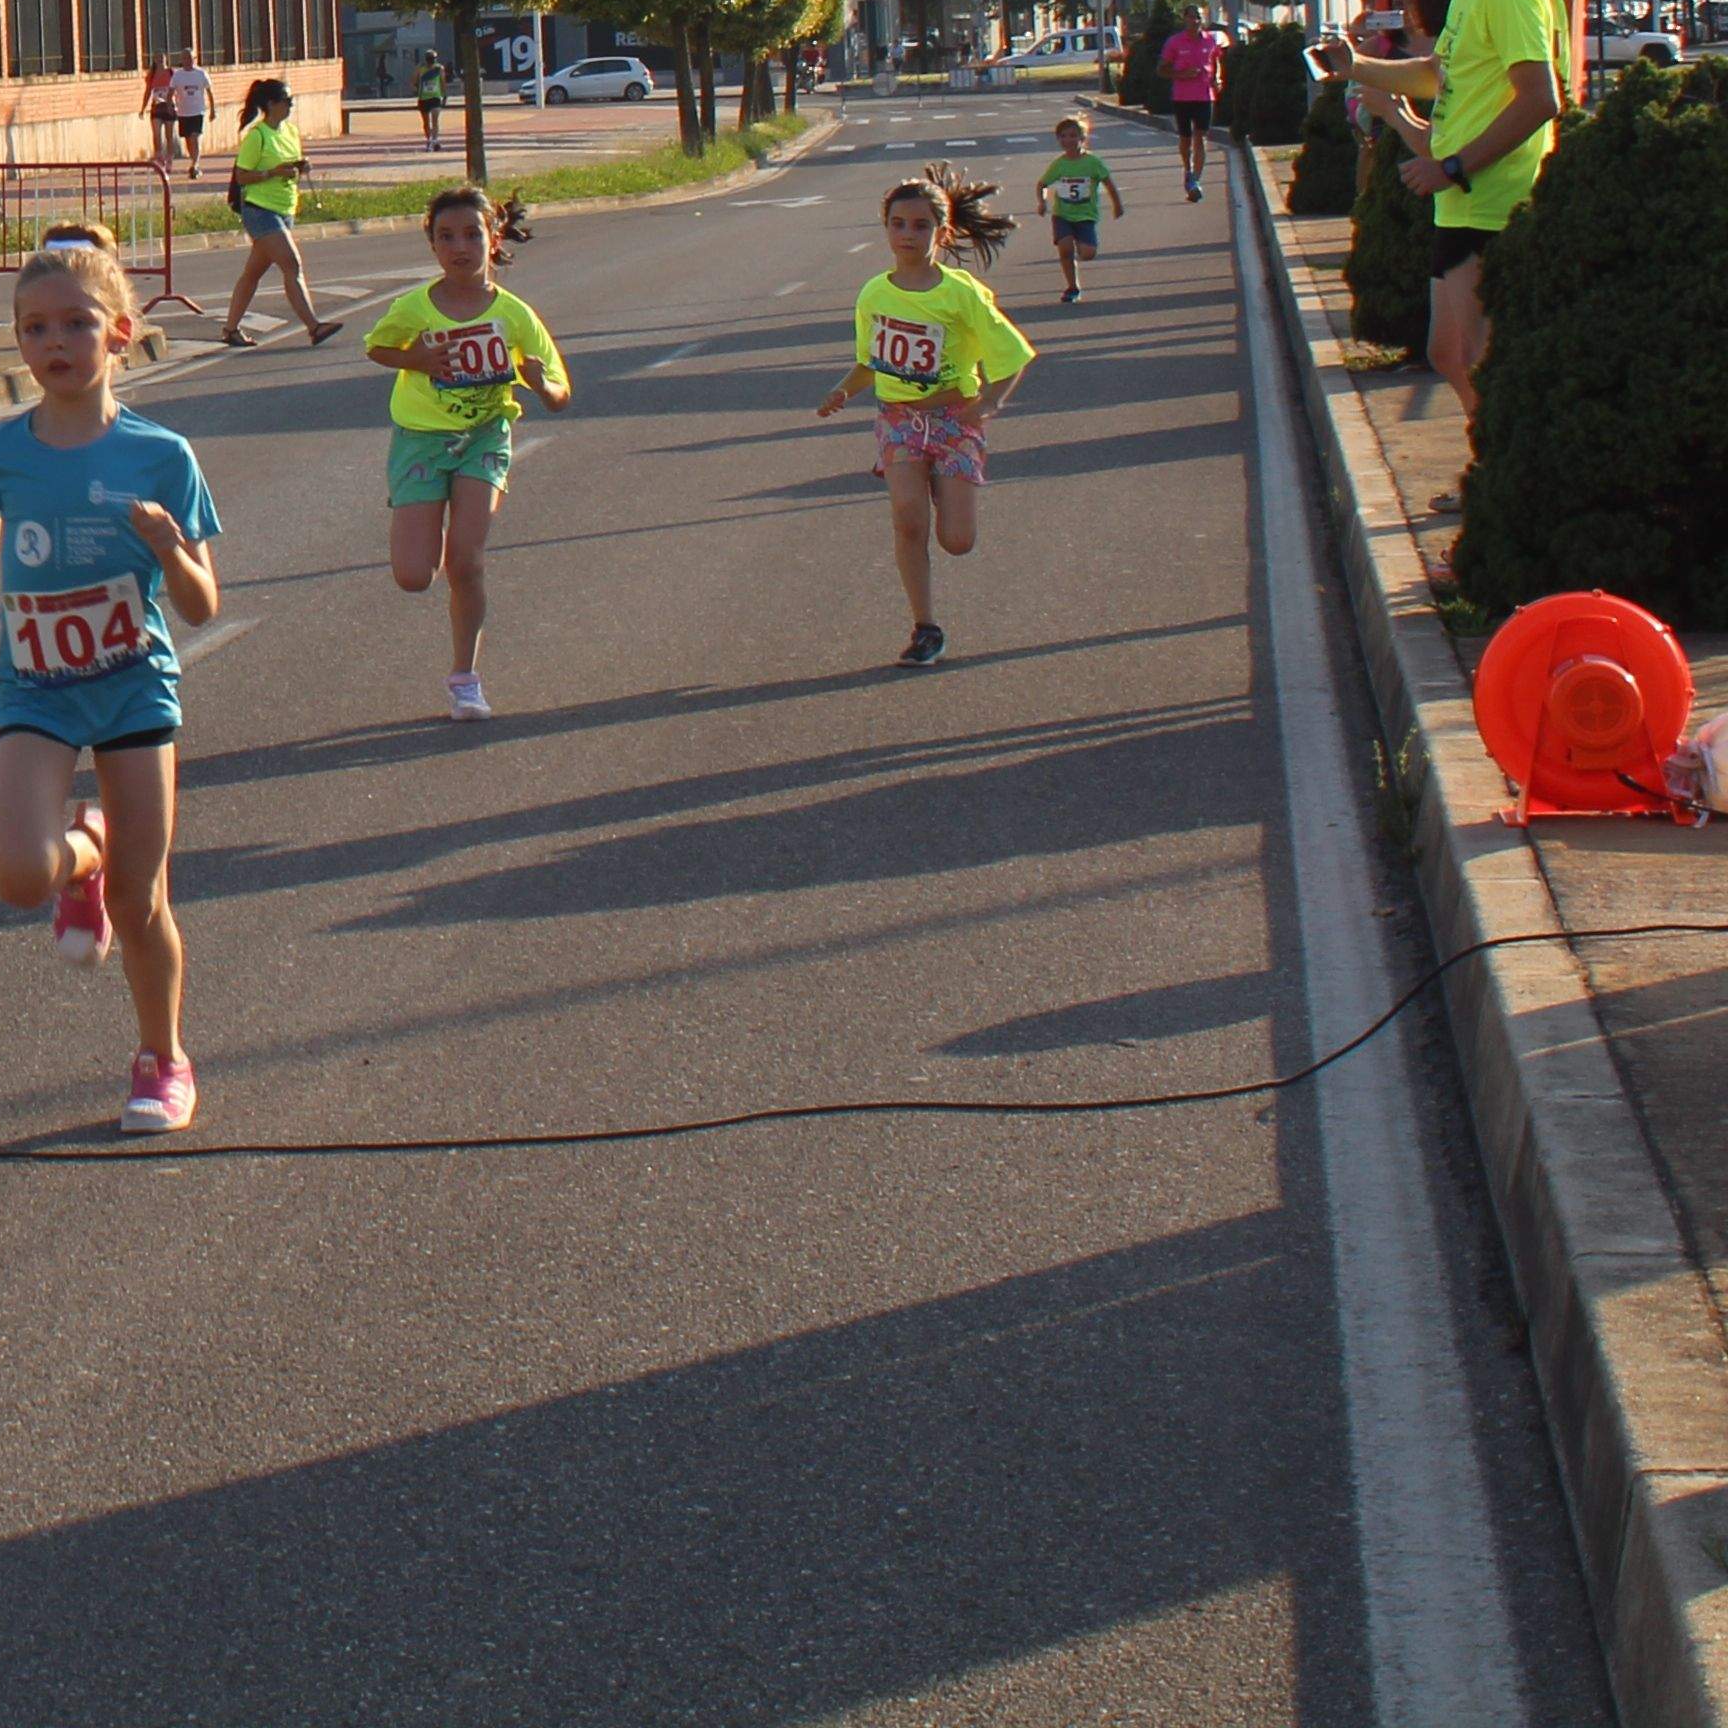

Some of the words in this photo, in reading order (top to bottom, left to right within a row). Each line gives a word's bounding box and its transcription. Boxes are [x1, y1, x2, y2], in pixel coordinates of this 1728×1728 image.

[495, 35, 535, 72] 19
[1069, 184, 1080, 199] 5
[875, 329, 937, 373] 103
[17, 601, 141, 672] 104
